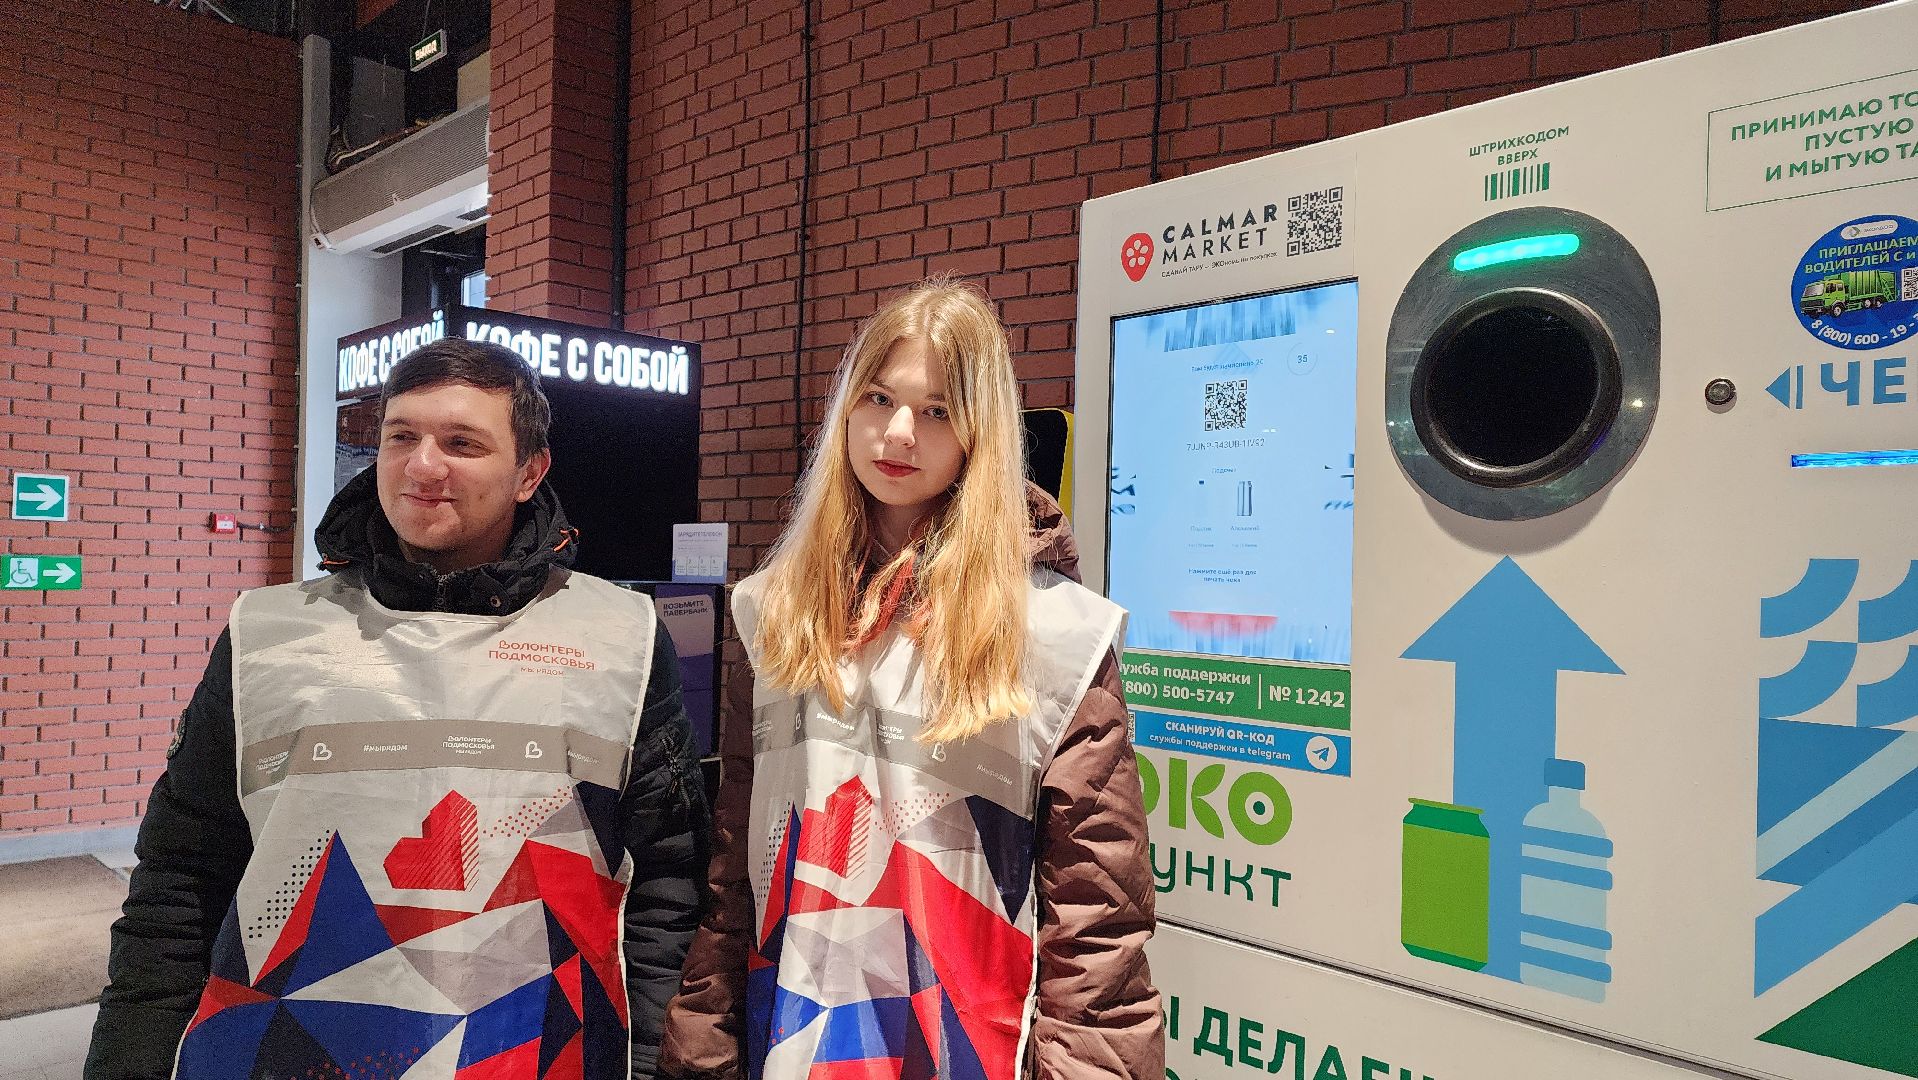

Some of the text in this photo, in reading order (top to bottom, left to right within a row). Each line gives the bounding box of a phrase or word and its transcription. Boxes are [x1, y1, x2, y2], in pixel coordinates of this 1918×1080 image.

[1731, 98, 1883, 141] ПРИНИМАЮ
[1805, 117, 1914, 151] ПУСТУЮ
[1469, 126, 1570, 157] ШТРИХКОДОМ
[1497, 148, 1538, 166] ВВЕРХ
[1765, 164, 1782, 182] И
[1788, 147, 1890, 178] МЫТУЮ
[1162, 203, 1278, 244] CALMAR
[1162, 227, 1268, 265] MARKET
[1189, 264, 1204, 272] ТАРУ
[1805, 250, 1890, 274] ВОДИТЕЛЕЙ
[1894, 250, 1904, 262] С
[1811, 320, 1823, 329] 8
[1818, 324, 1852, 346] (800)
[1854, 334, 1880, 344] 600
[1890, 324, 1908, 338] 19
[338, 339, 378, 393] КОФЕ
[567, 338, 588, 381] С
[593, 341, 690, 396] СОБОЙ
[1297, 354, 1308, 364] 35
[1821, 356, 1907, 406] ЧЕ
[663, 600, 704, 610] ВОЗЬМИТЕ
[663, 607, 708, 617] ПАВЕРБАНК
[1120, 662, 1251, 685] ужба поддержки
[1162, 685, 1235, 705] 500-5747
[1149, 734, 1182, 745] службы
[1186, 738, 1238, 753] поддержки
[1248, 746, 1291, 761] telegram
[1166, 721, 1275, 746] СКАНИРУЙ QR-КОД
[1150, 842, 1292, 908] УНКТ
[1193, 1006, 1434, 1080] ДЕЛАЕ
